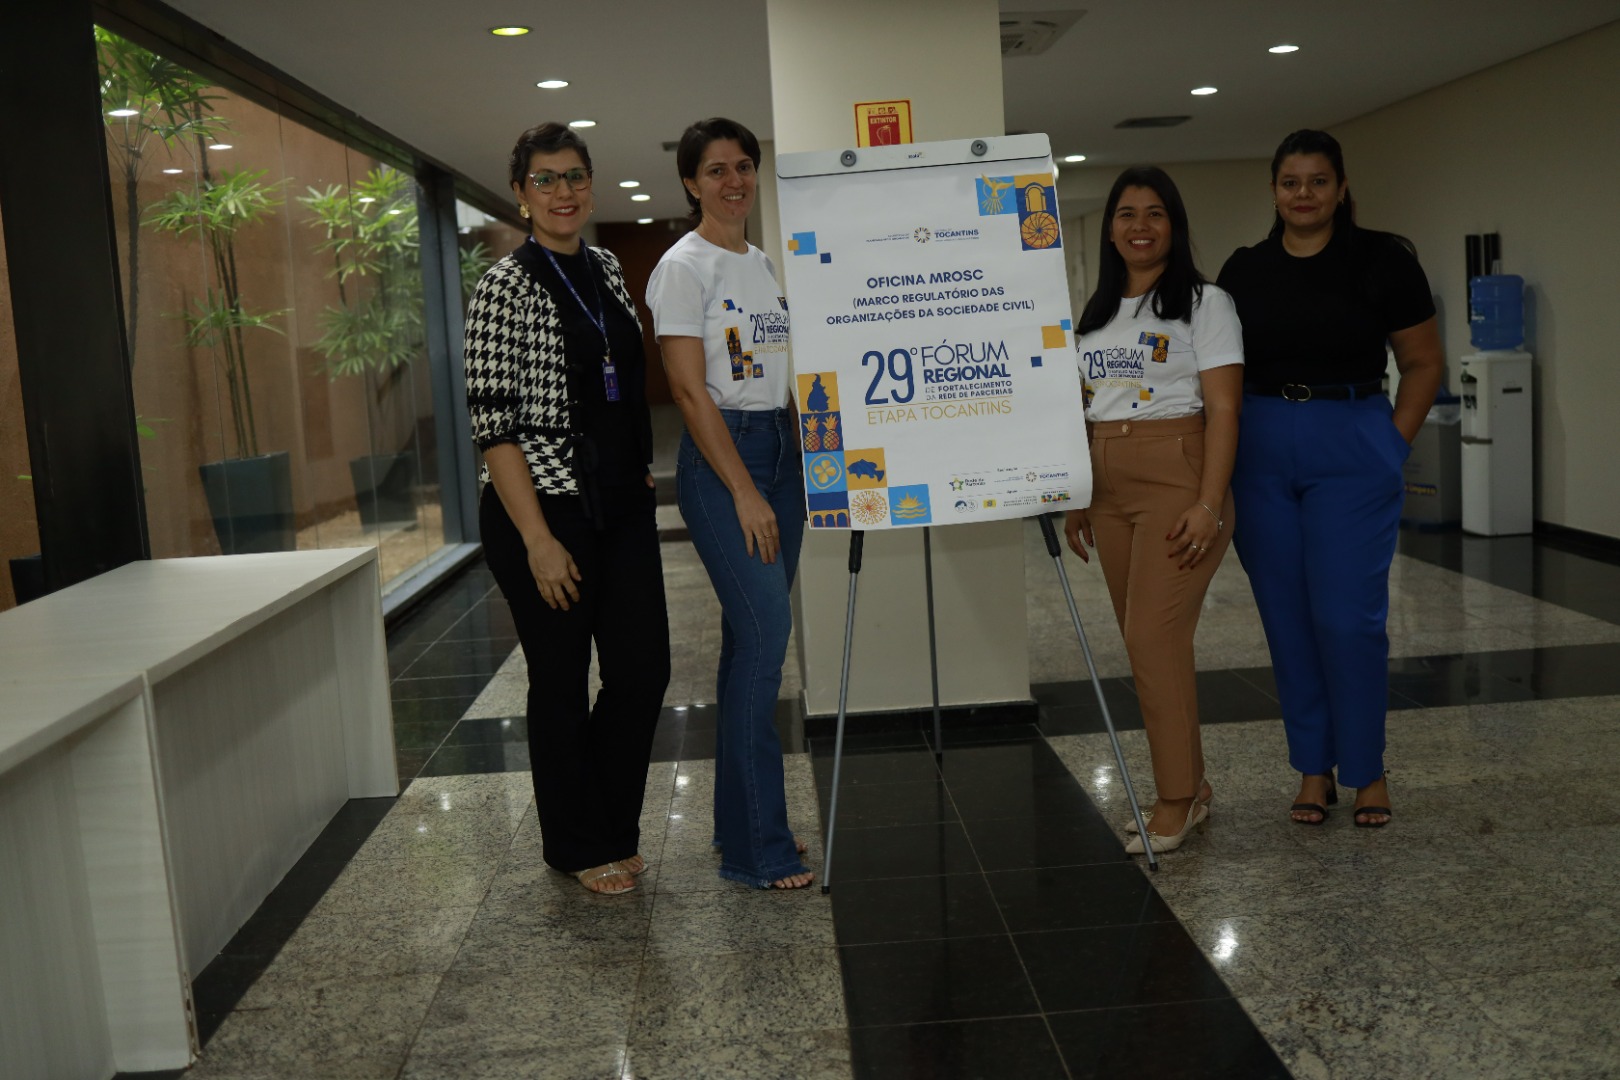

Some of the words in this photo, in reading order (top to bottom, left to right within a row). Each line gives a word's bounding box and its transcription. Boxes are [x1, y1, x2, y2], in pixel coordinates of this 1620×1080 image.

[870, 116, 897, 124] EXTINTOR
[934, 229, 979, 238] TOCANTINS
[866, 273, 926, 289] OFICINA
[929, 269, 984, 284] MROSC
[852, 295, 900, 309] (MARCO
[902, 287, 980, 304] REGULATÓRIO
[981, 286, 1005, 297] DAS
[826, 308, 916, 326] ORGANIZAÇÕES
[918, 308, 934, 318] DA
[937, 302, 1000, 317] SOCIEDADE
[1002, 299, 1035, 311] CIVIL)
[921, 339, 1010, 367] FÓRUM
[1106, 345, 1144, 361] FÓRUM
[923, 363, 1011, 384] REGIONAL
[1106, 360, 1144, 370] REGIONAL
[925, 386, 936, 394] DE
[938, 380, 1013, 392] FORTALECIMENTO
[970, 388, 1013, 397] PARCERIAS
[867, 409, 918, 425] ETAPA
[920, 400, 1013, 421] TOCANTINS
